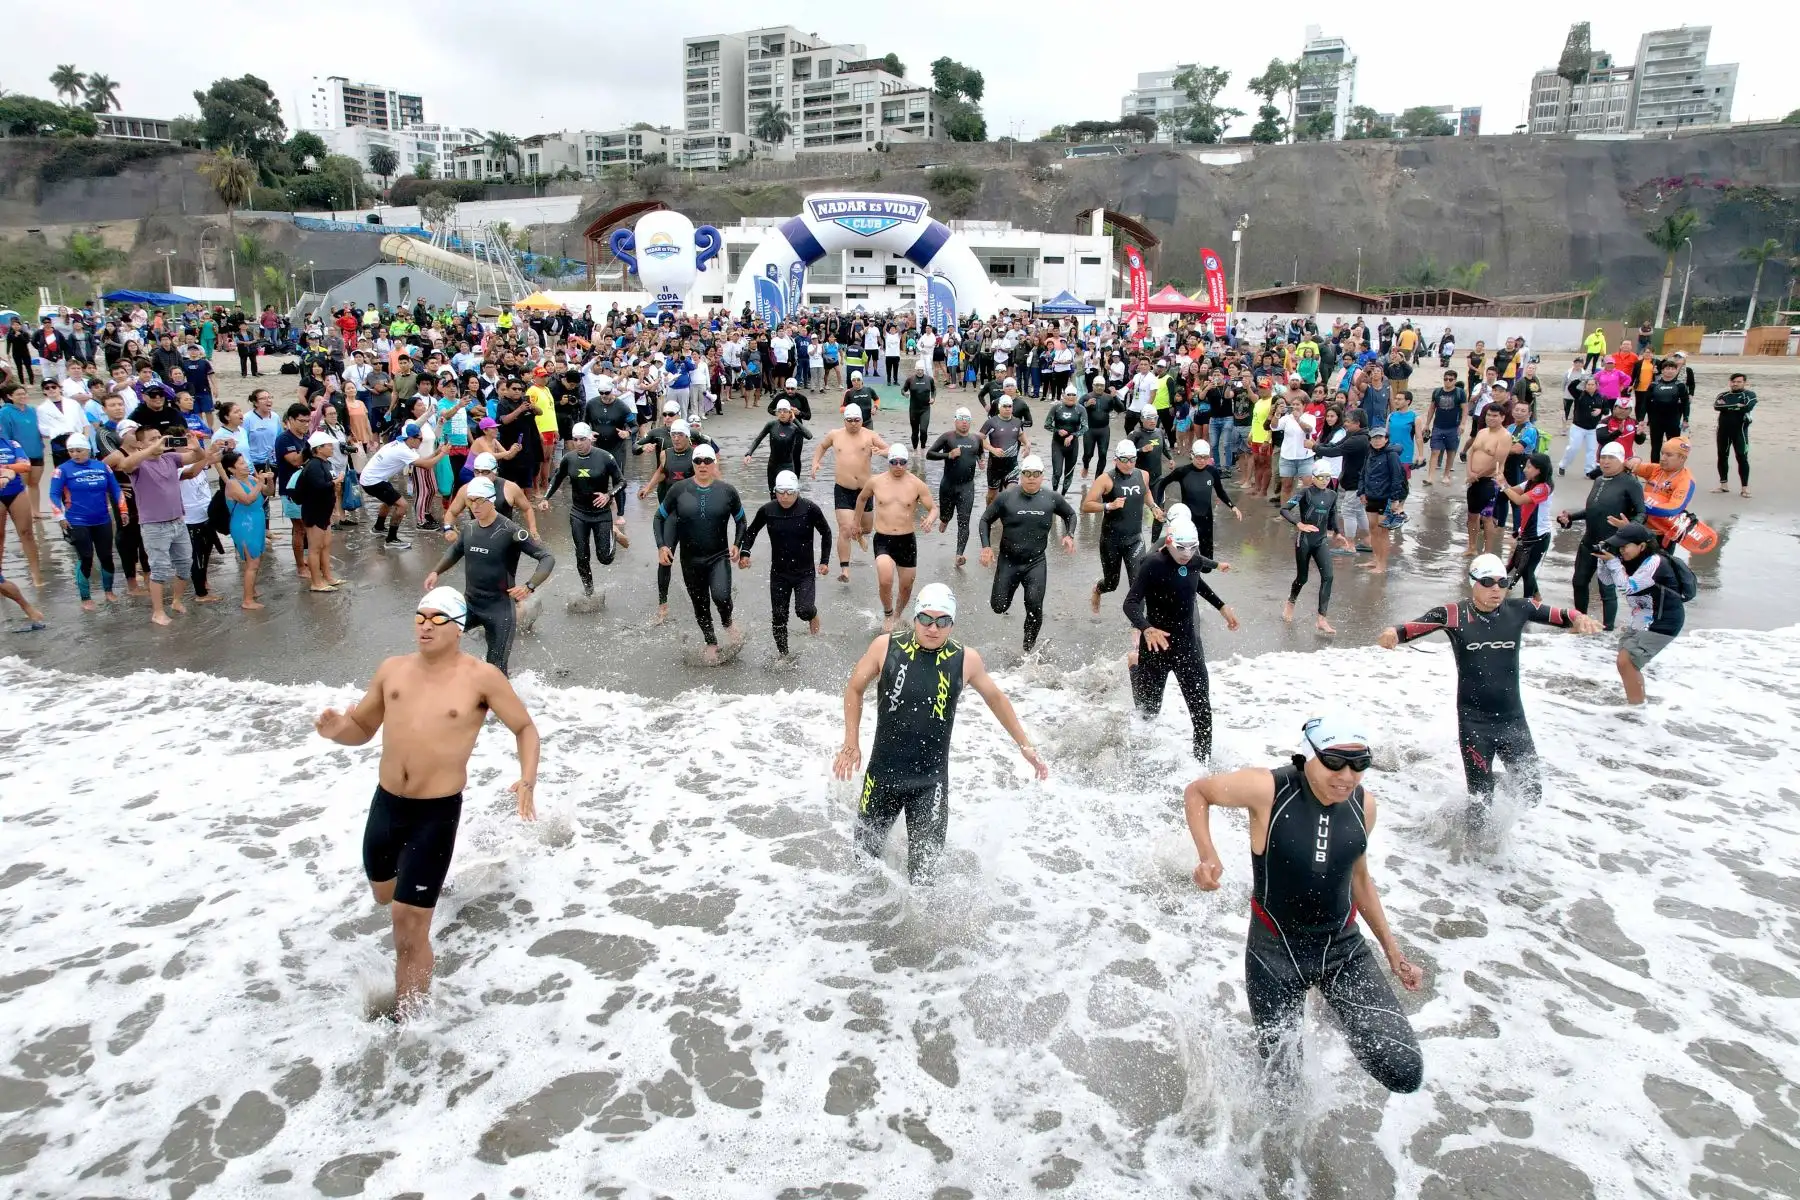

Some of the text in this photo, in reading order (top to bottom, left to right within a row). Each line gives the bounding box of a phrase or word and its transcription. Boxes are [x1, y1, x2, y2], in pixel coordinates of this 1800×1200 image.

[817, 201, 917, 216] NADAR ES VIDA
[853, 220, 882, 228] CLUB
[1121, 485, 1141, 496] TYR
[1466, 641, 1516, 652] orca
[888, 662, 909, 713] KONA
[931, 781, 943, 821] KONA
[1315, 813, 1330, 863] HUUB
